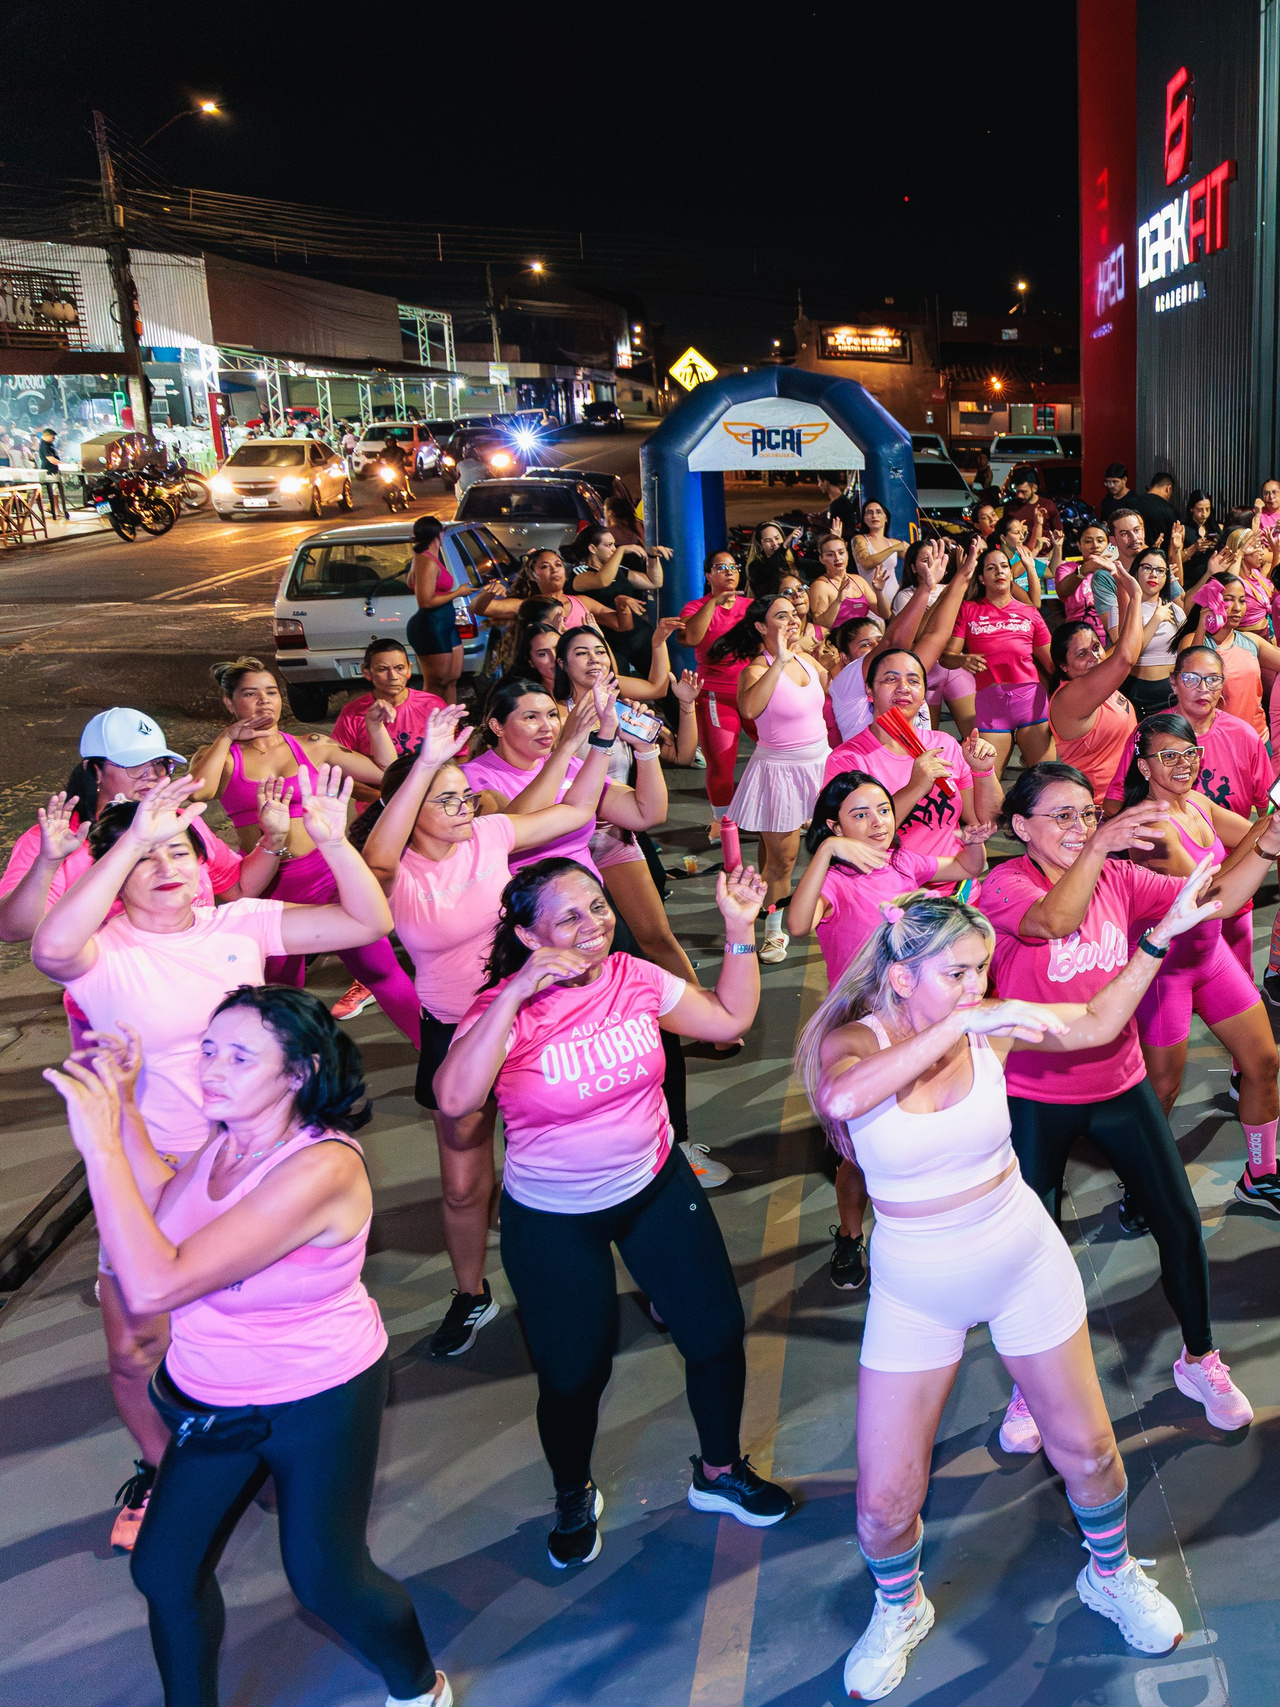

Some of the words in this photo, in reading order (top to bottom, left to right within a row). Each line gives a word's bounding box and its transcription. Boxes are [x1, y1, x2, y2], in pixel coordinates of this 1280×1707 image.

[1154, 281, 1200, 313] ACADEMIA
[1047, 920, 1129, 983] Barbie
[540, 1012, 660, 1086] OUTUBRO
[577, 1062, 650, 1100] ROSA
[1248, 1132, 1263, 1165] adidas
